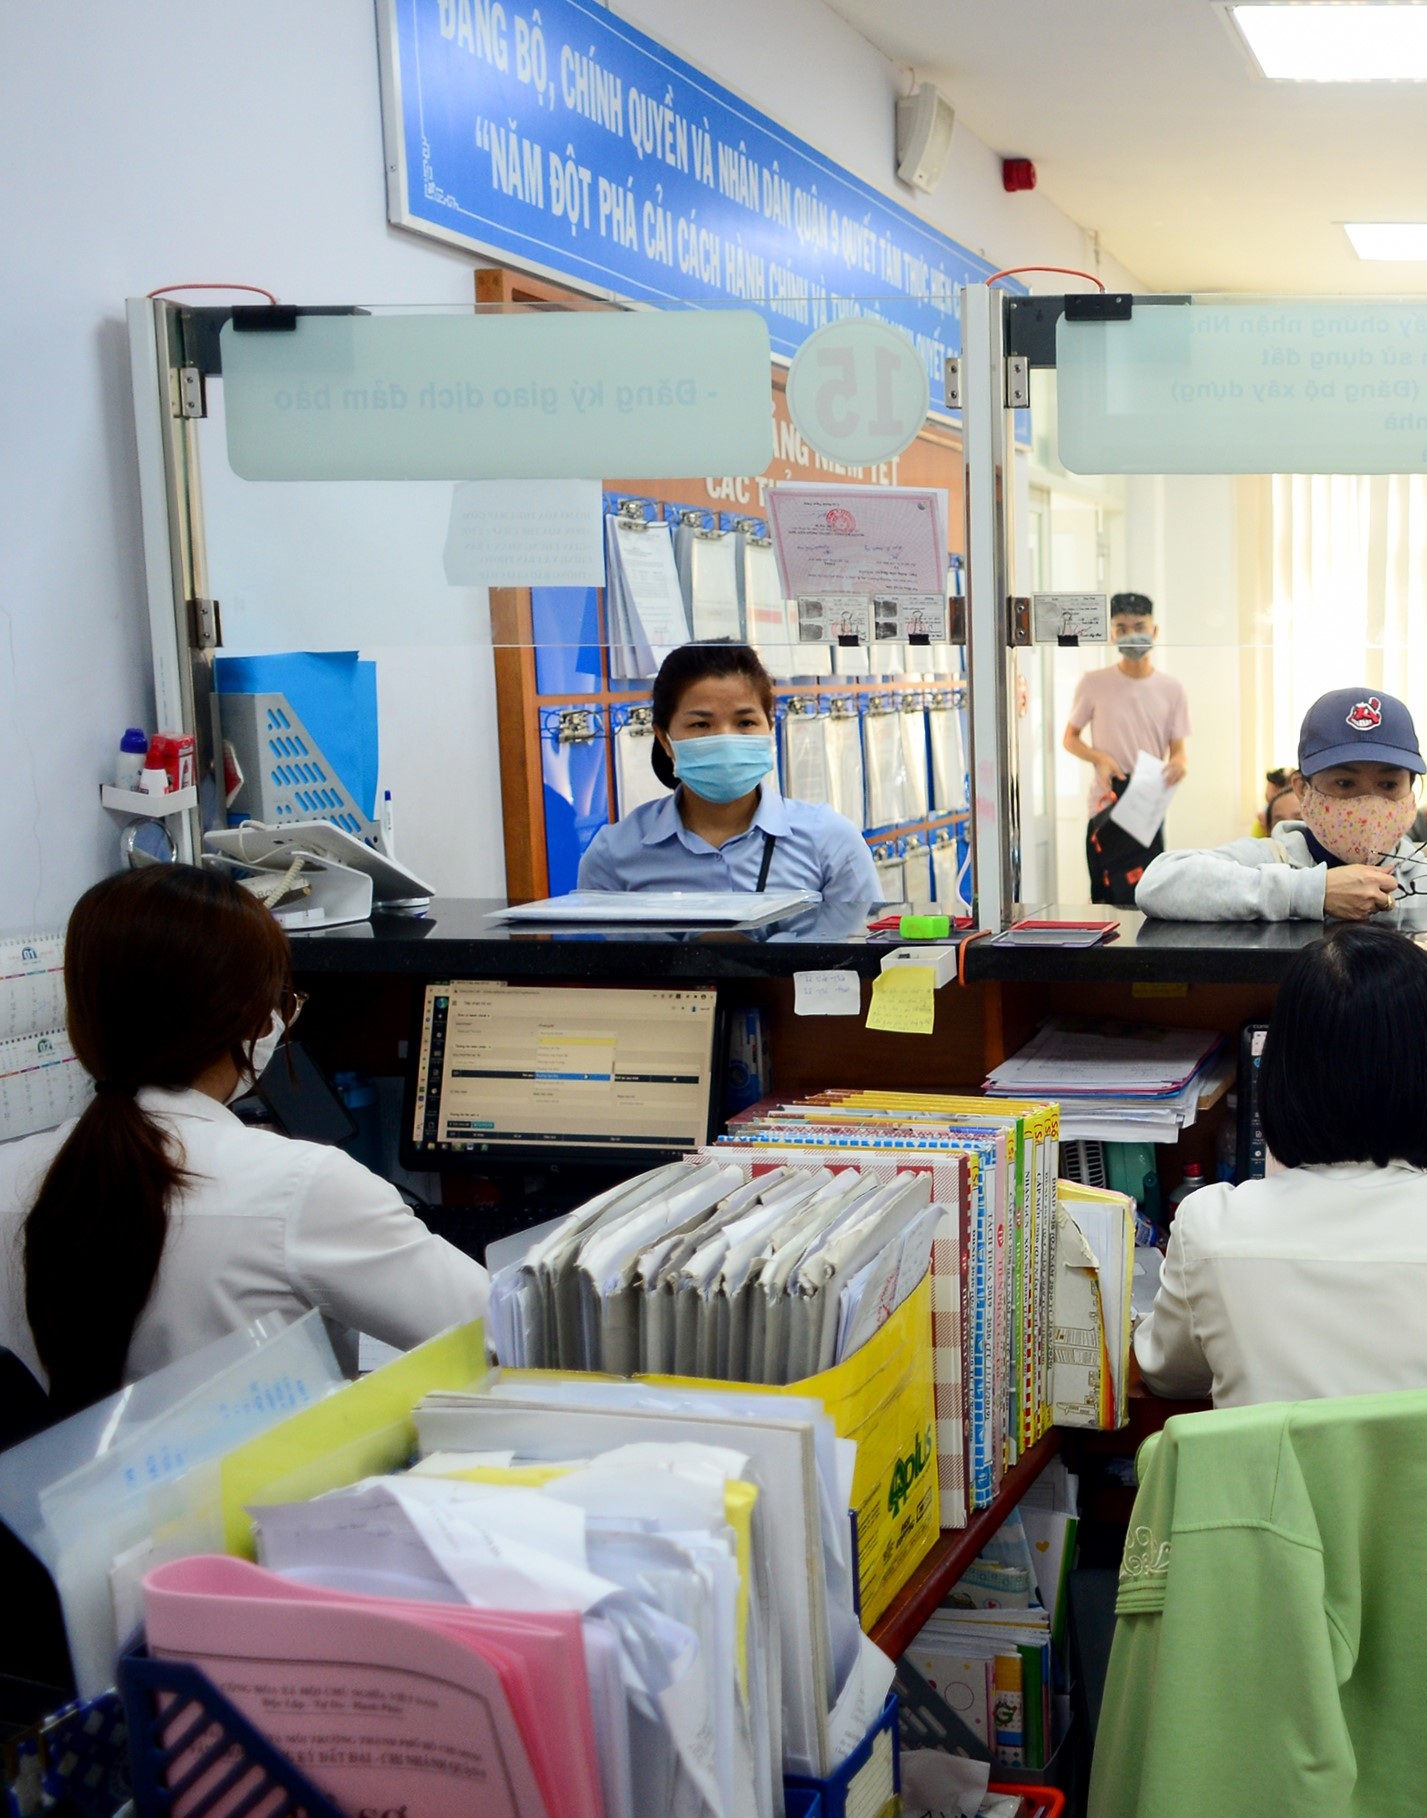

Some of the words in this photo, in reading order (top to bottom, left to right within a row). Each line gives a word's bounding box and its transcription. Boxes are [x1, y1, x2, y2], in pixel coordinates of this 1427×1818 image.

[561, 44, 623, 138] CHÍNH
[628, 84, 688, 174] QUYỀN
[691, 116, 714, 188] VÀ
[718, 140, 759, 213] NHÂN
[763, 160, 792, 229] DÂN
[549, 143, 591, 236] ĐỘT
[598, 175, 638, 247] PHÁ
[642, 184, 673, 265] CẢI
[678, 207, 721, 288] CÁCH
[725, 232, 765, 307] HÀNH
[769, 258, 808, 325] CHÍNH
